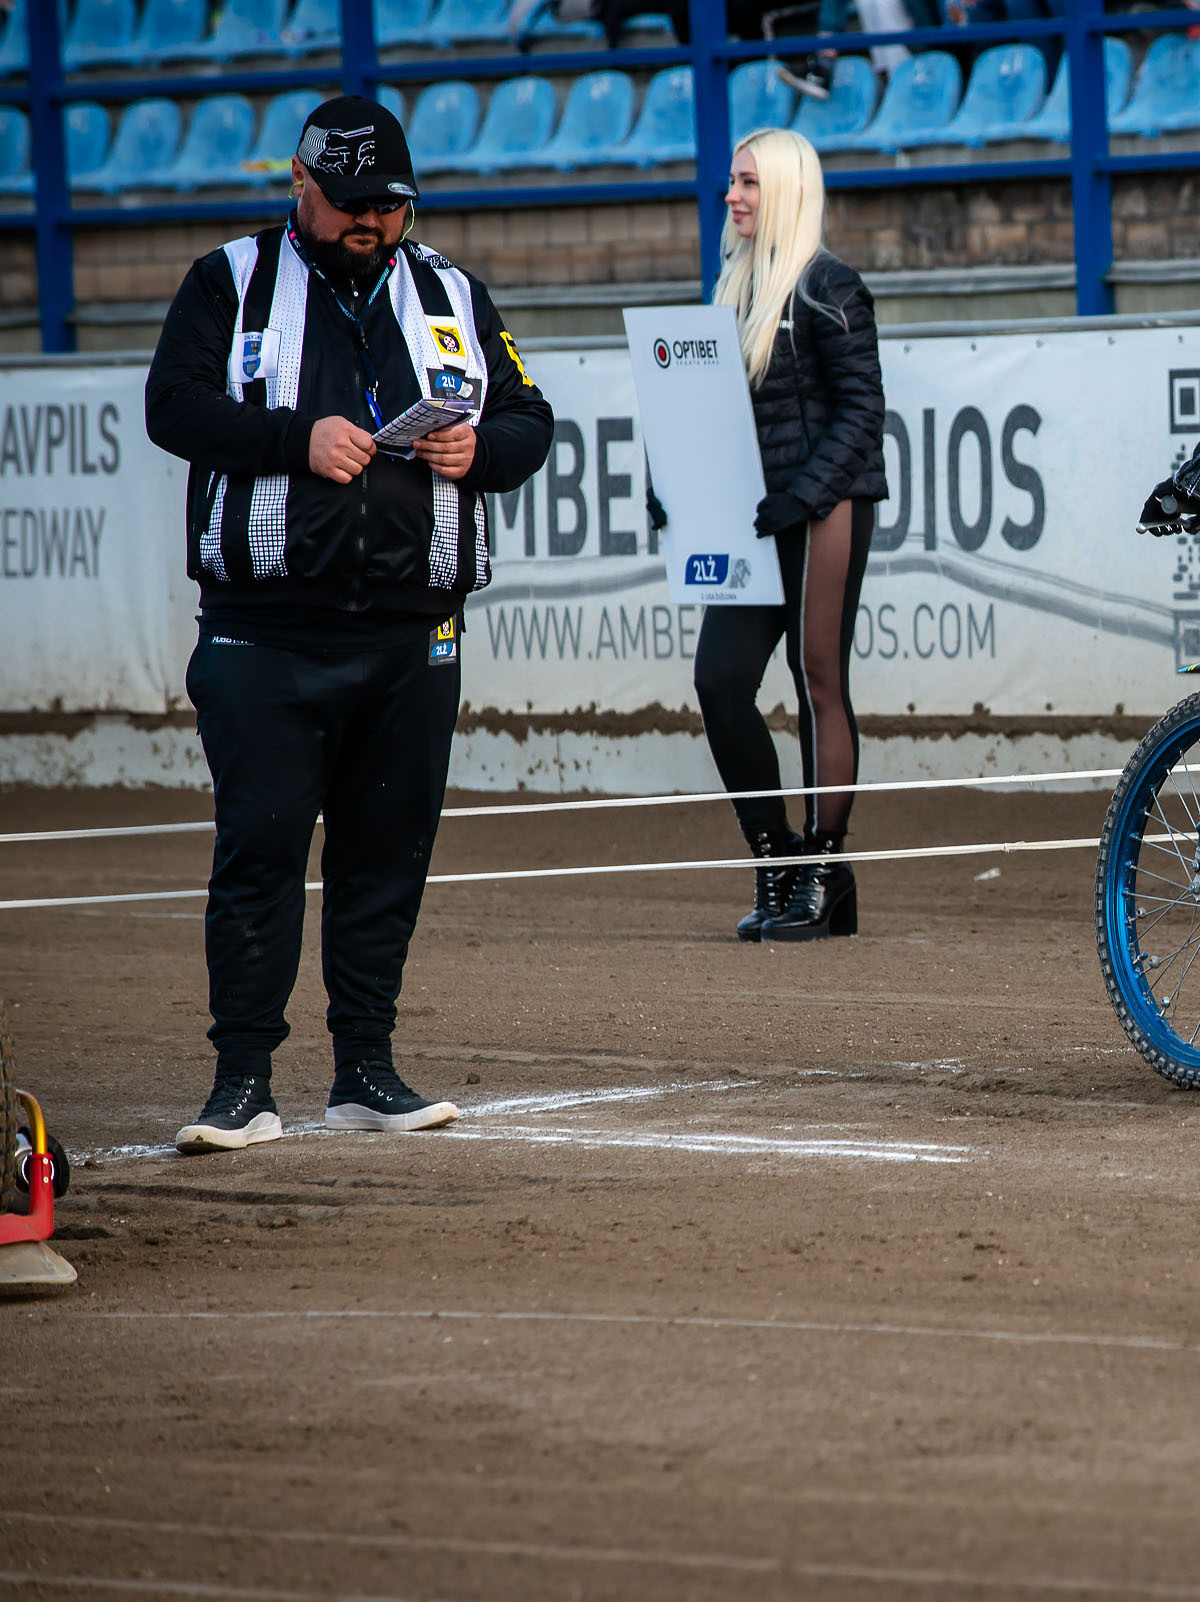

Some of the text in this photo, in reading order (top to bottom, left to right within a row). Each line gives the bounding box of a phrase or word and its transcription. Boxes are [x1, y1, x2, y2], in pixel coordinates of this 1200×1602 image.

[673, 339, 719, 360] OPTIBET
[486, 416, 659, 558] MBE
[0, 508, 106, 579] EDWAY
[693, 555, 718, 582] 2LŻ
